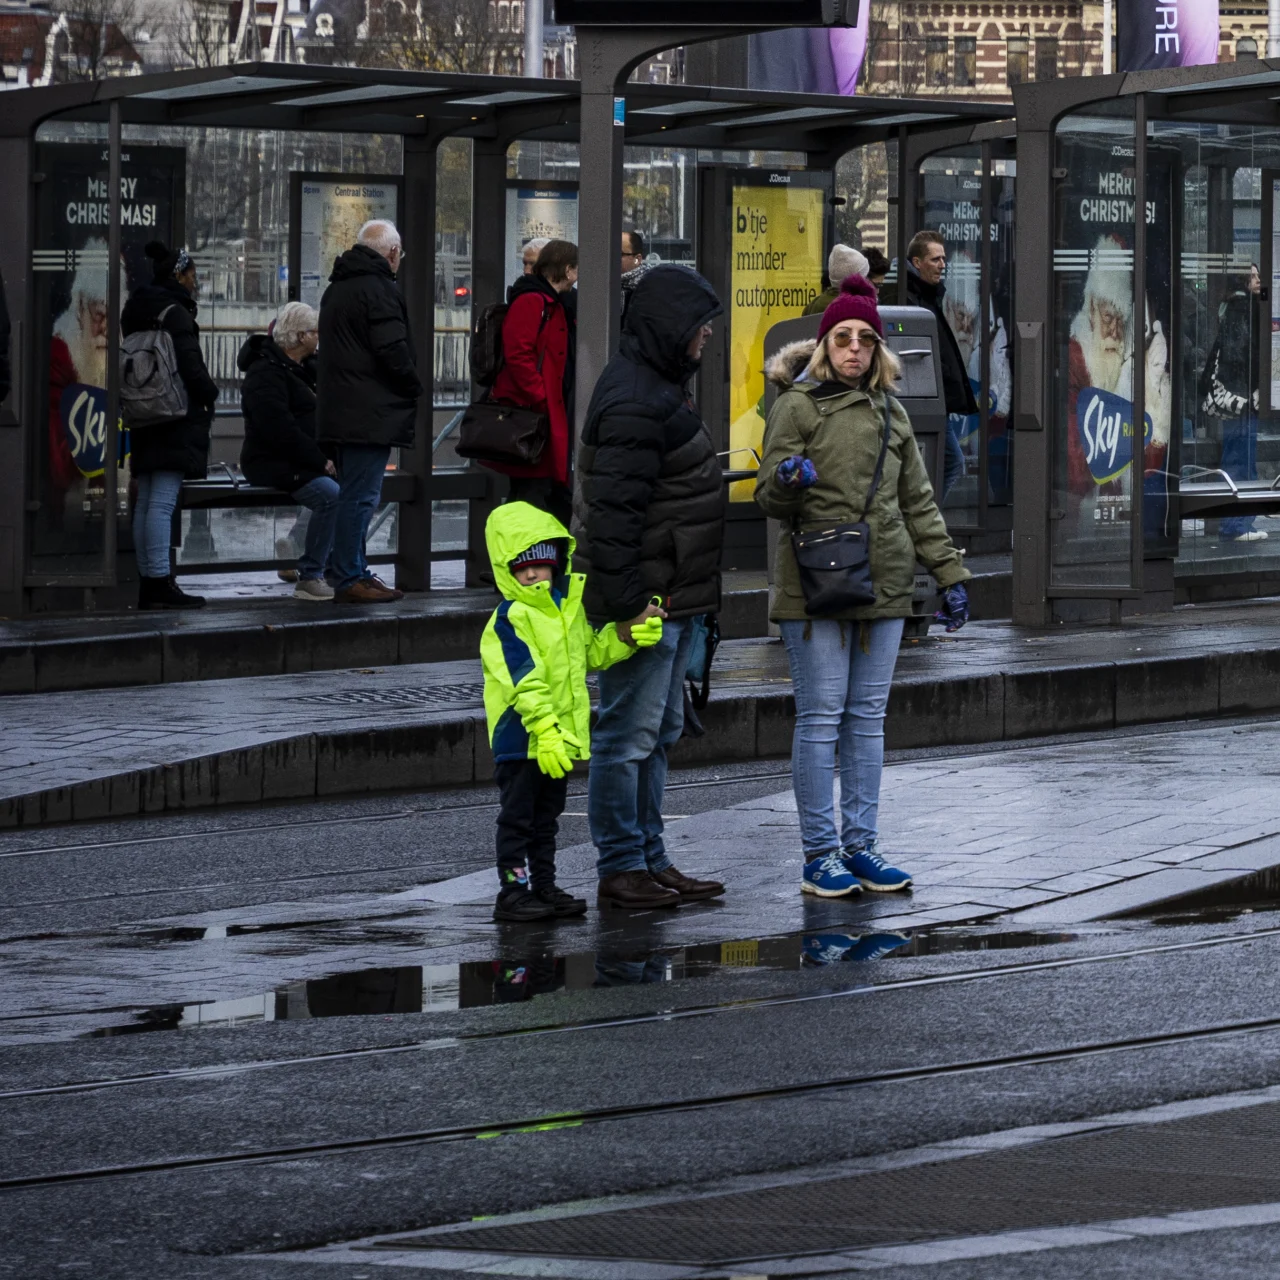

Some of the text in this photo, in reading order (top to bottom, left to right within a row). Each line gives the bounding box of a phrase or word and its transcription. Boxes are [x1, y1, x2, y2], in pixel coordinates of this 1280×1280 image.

[88, 176, 138, 199] MERY
[334, 186, 384, 198] Centraal Station
[1099, 172, 1136, 195] MERR
[66, 202, 156, 226] CHRISMAS!
[1080, 199, 1155, 224] CHRISTMS!
[939, 223, 999, 241] CHRISTMS!
[737, 244, 787, 271] minder
[736, 282, 817, 316] autopremie
[1084, 394, 1121, 469] Sky
